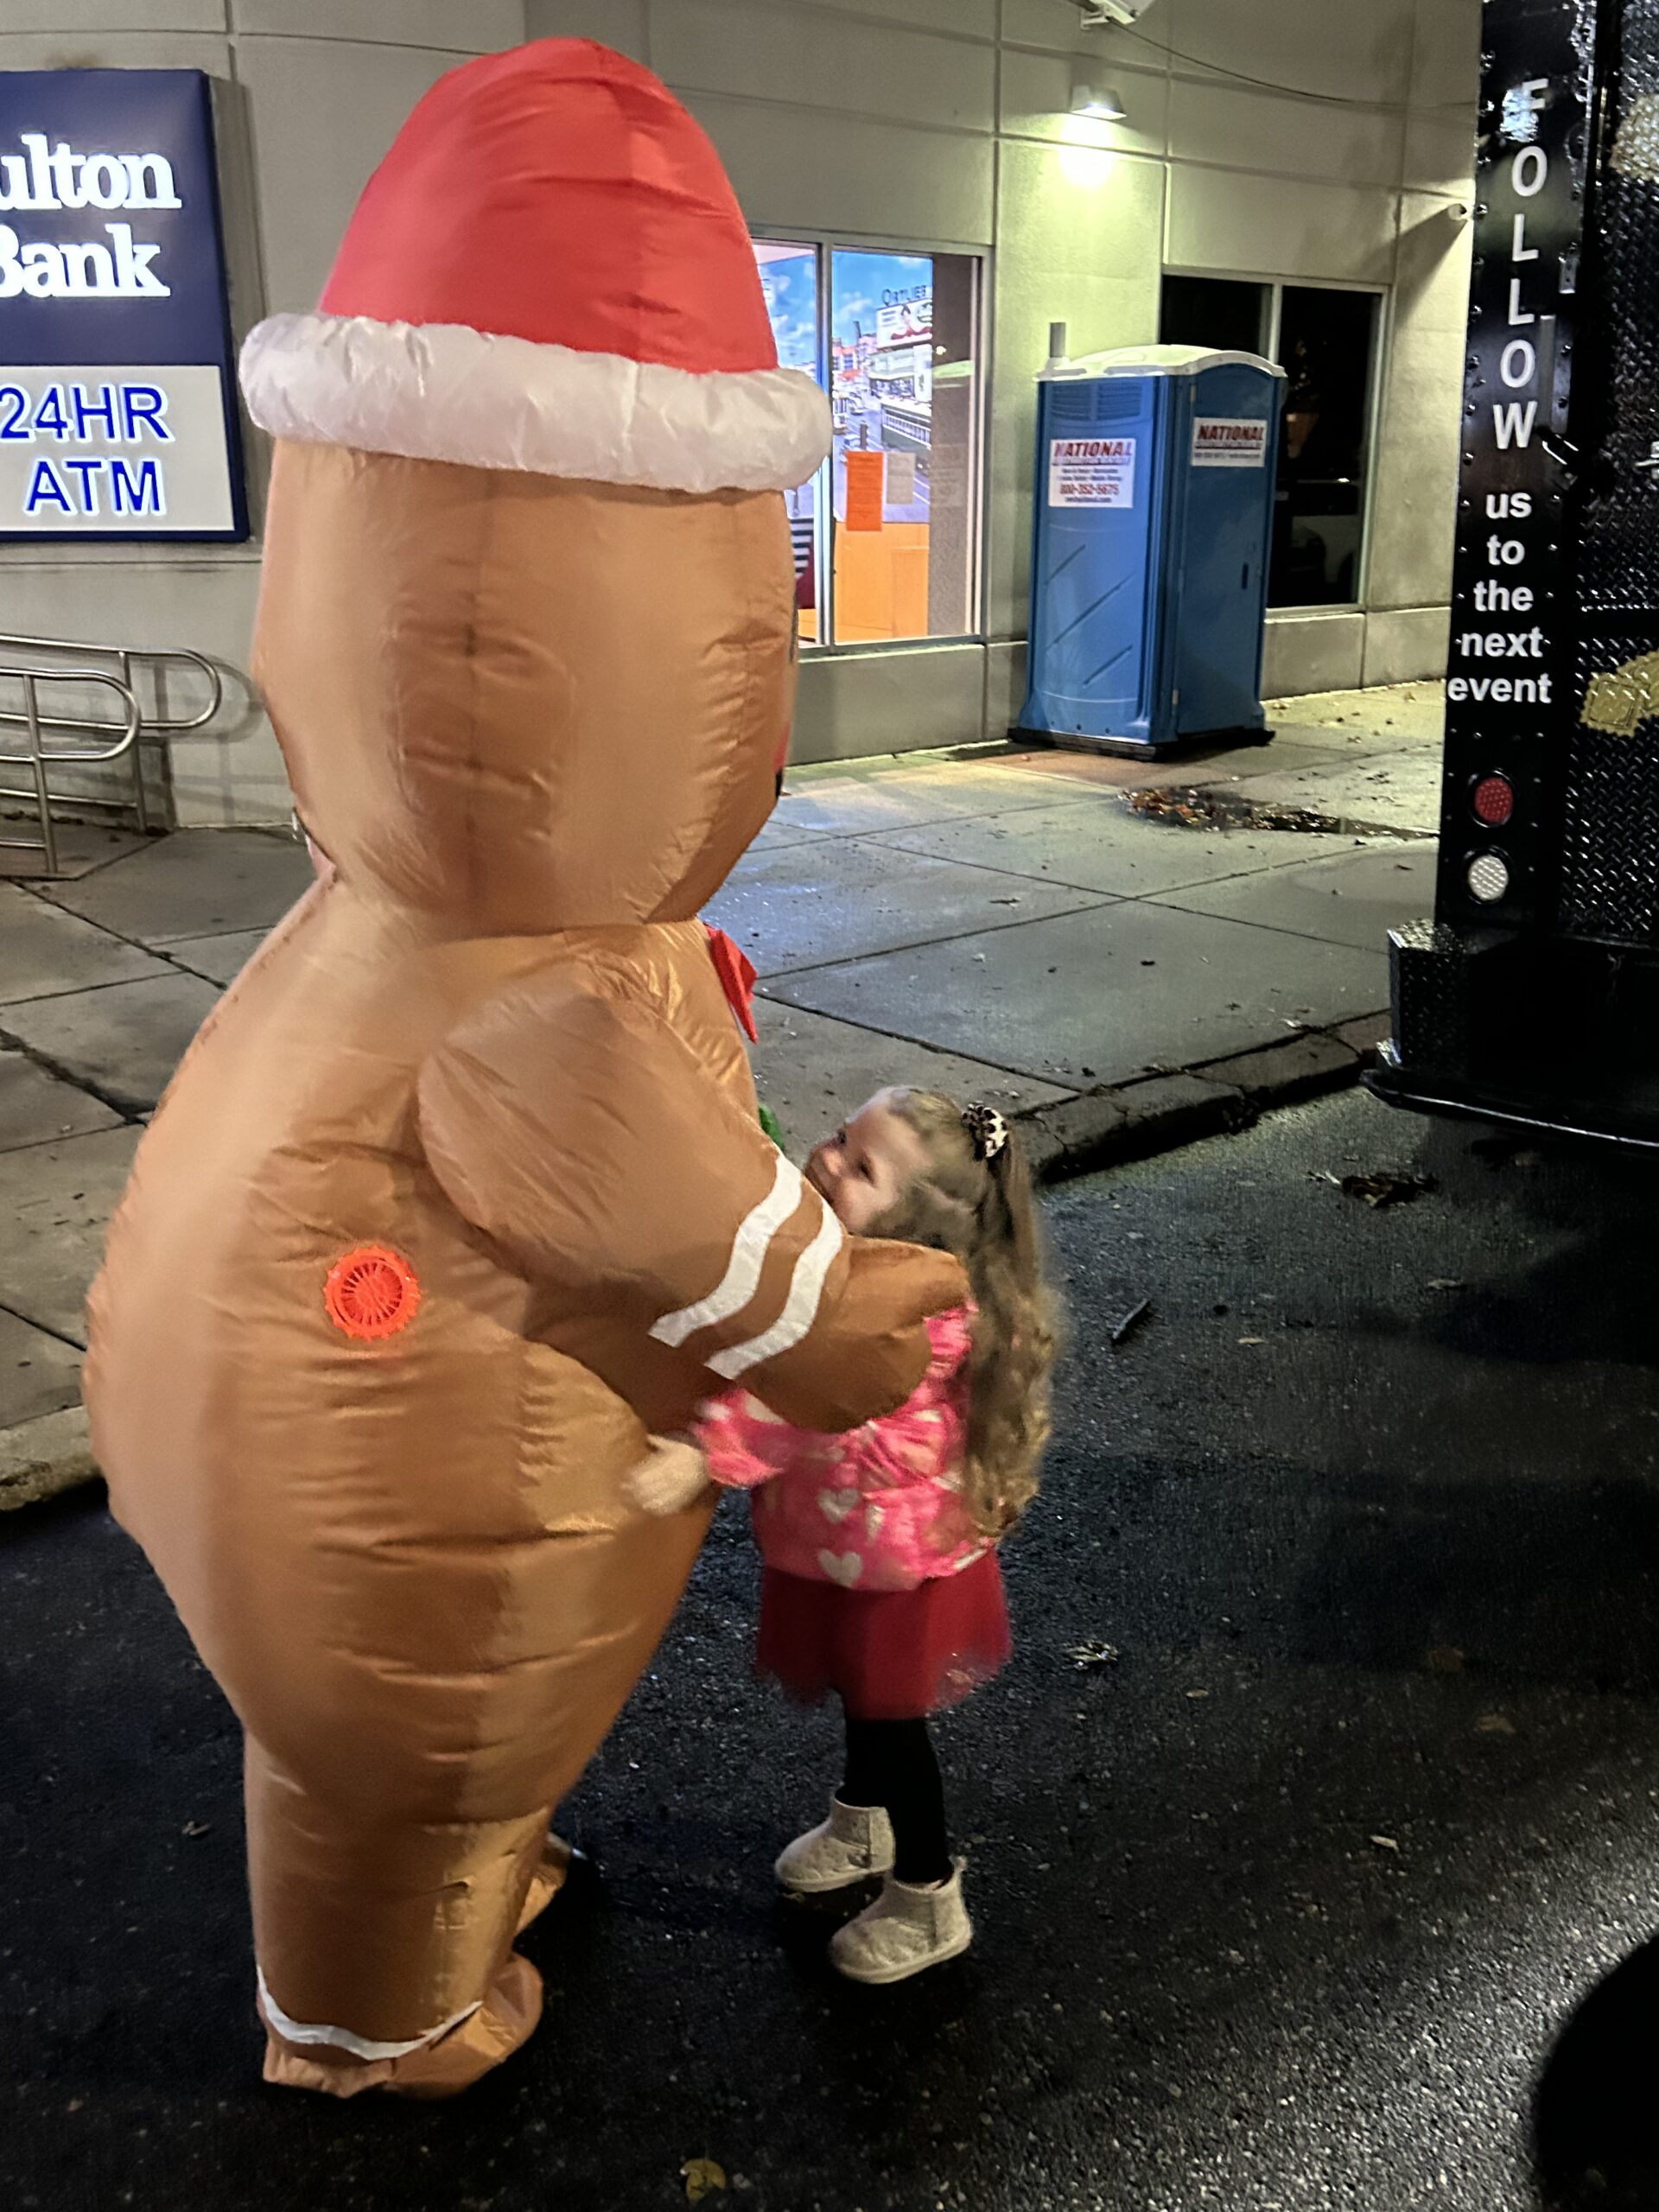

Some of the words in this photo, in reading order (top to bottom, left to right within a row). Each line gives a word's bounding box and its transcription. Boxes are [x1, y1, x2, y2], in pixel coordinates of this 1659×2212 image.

[0, 382, 176, 444] 24HR
[1054, 441, 1132, 457] NATIONAL
[1198, 425, 1264, 441] NATIONAL
[23, 456, 167, 518] ATM
[1485, 492, 1532, 519] us
[1486, 534, 1526, 566] to
[1473, 579, 1534, 612] the
[1460, 626, 1543, 658] next
[1447, 672, 1553, 704] event
